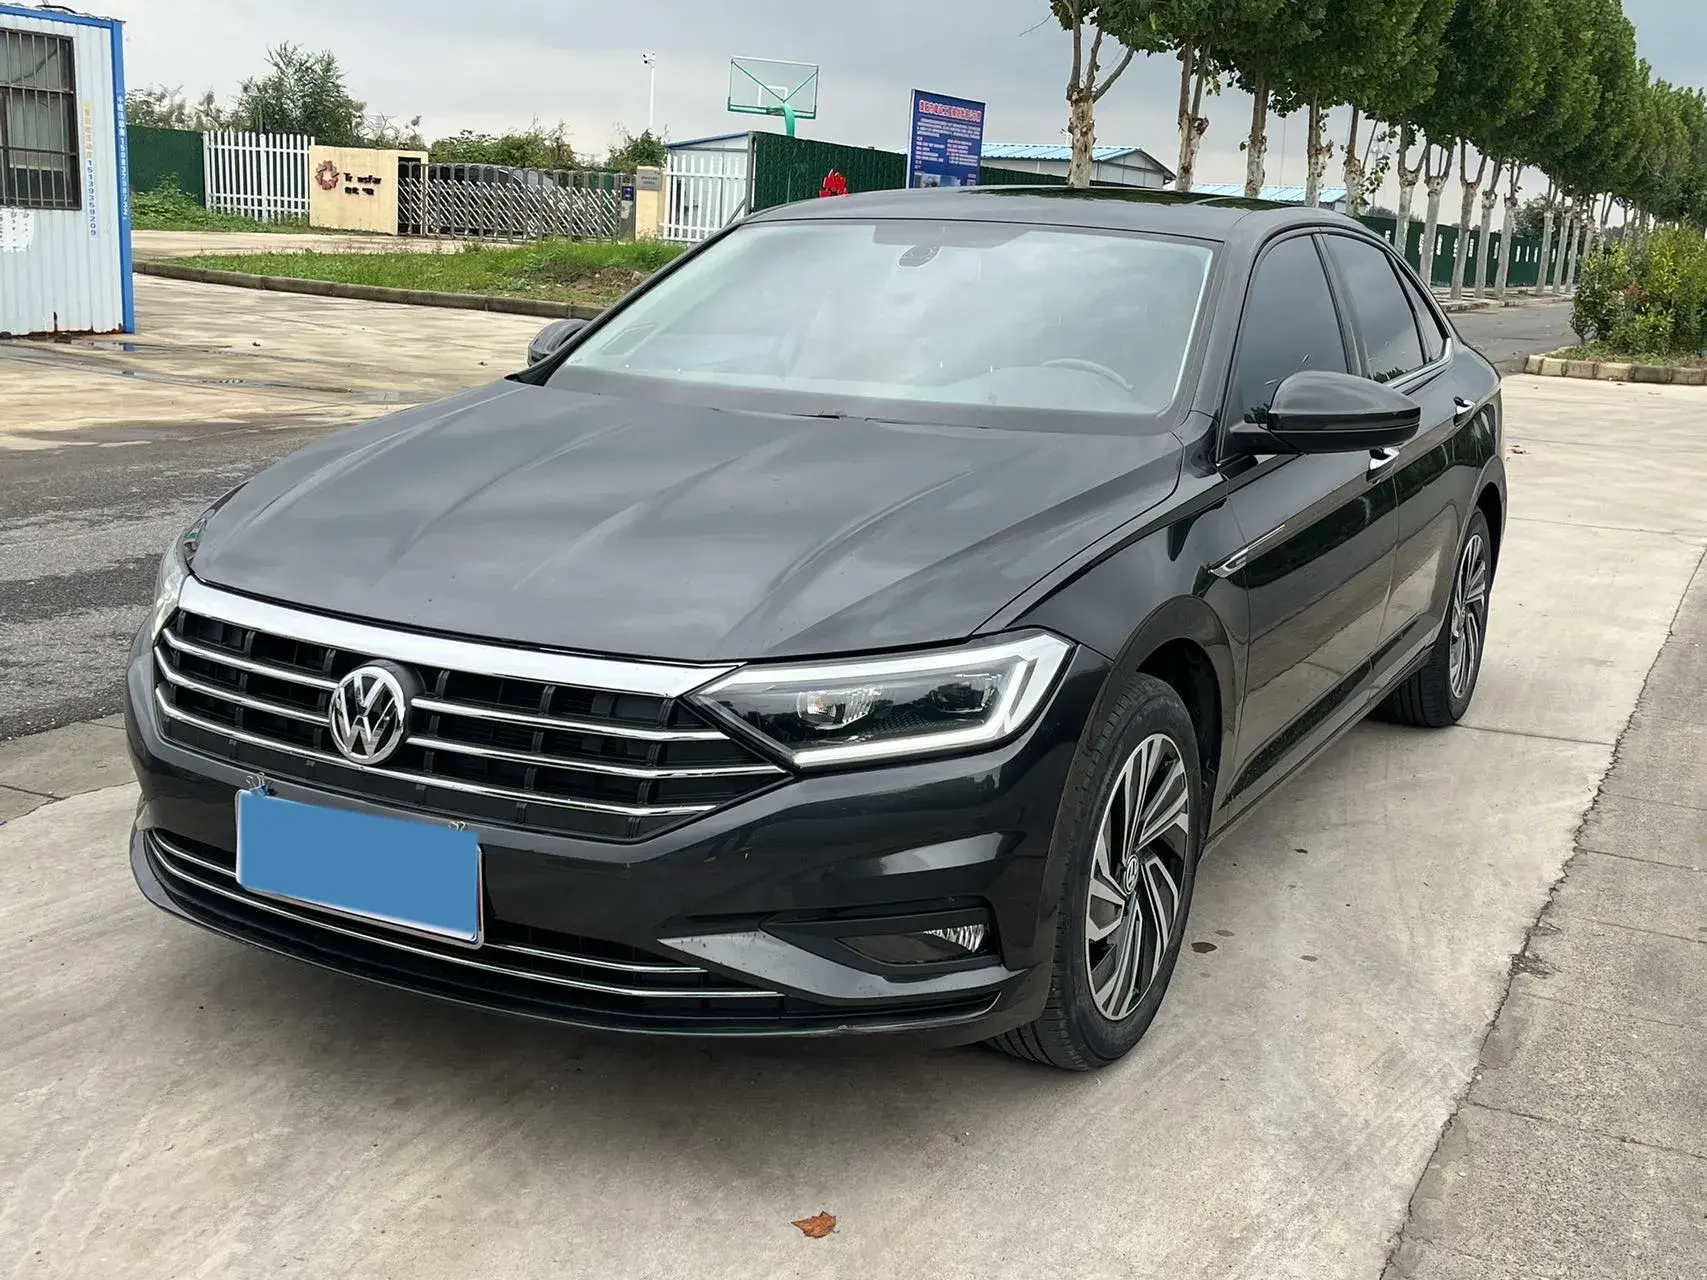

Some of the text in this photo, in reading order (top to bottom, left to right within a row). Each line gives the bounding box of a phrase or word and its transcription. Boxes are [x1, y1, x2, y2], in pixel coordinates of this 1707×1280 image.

[87, 160, 97, 236] 15139359209
[343, 172, 382, 184] Trnsfar
[331, 668, 403, 762] VW
